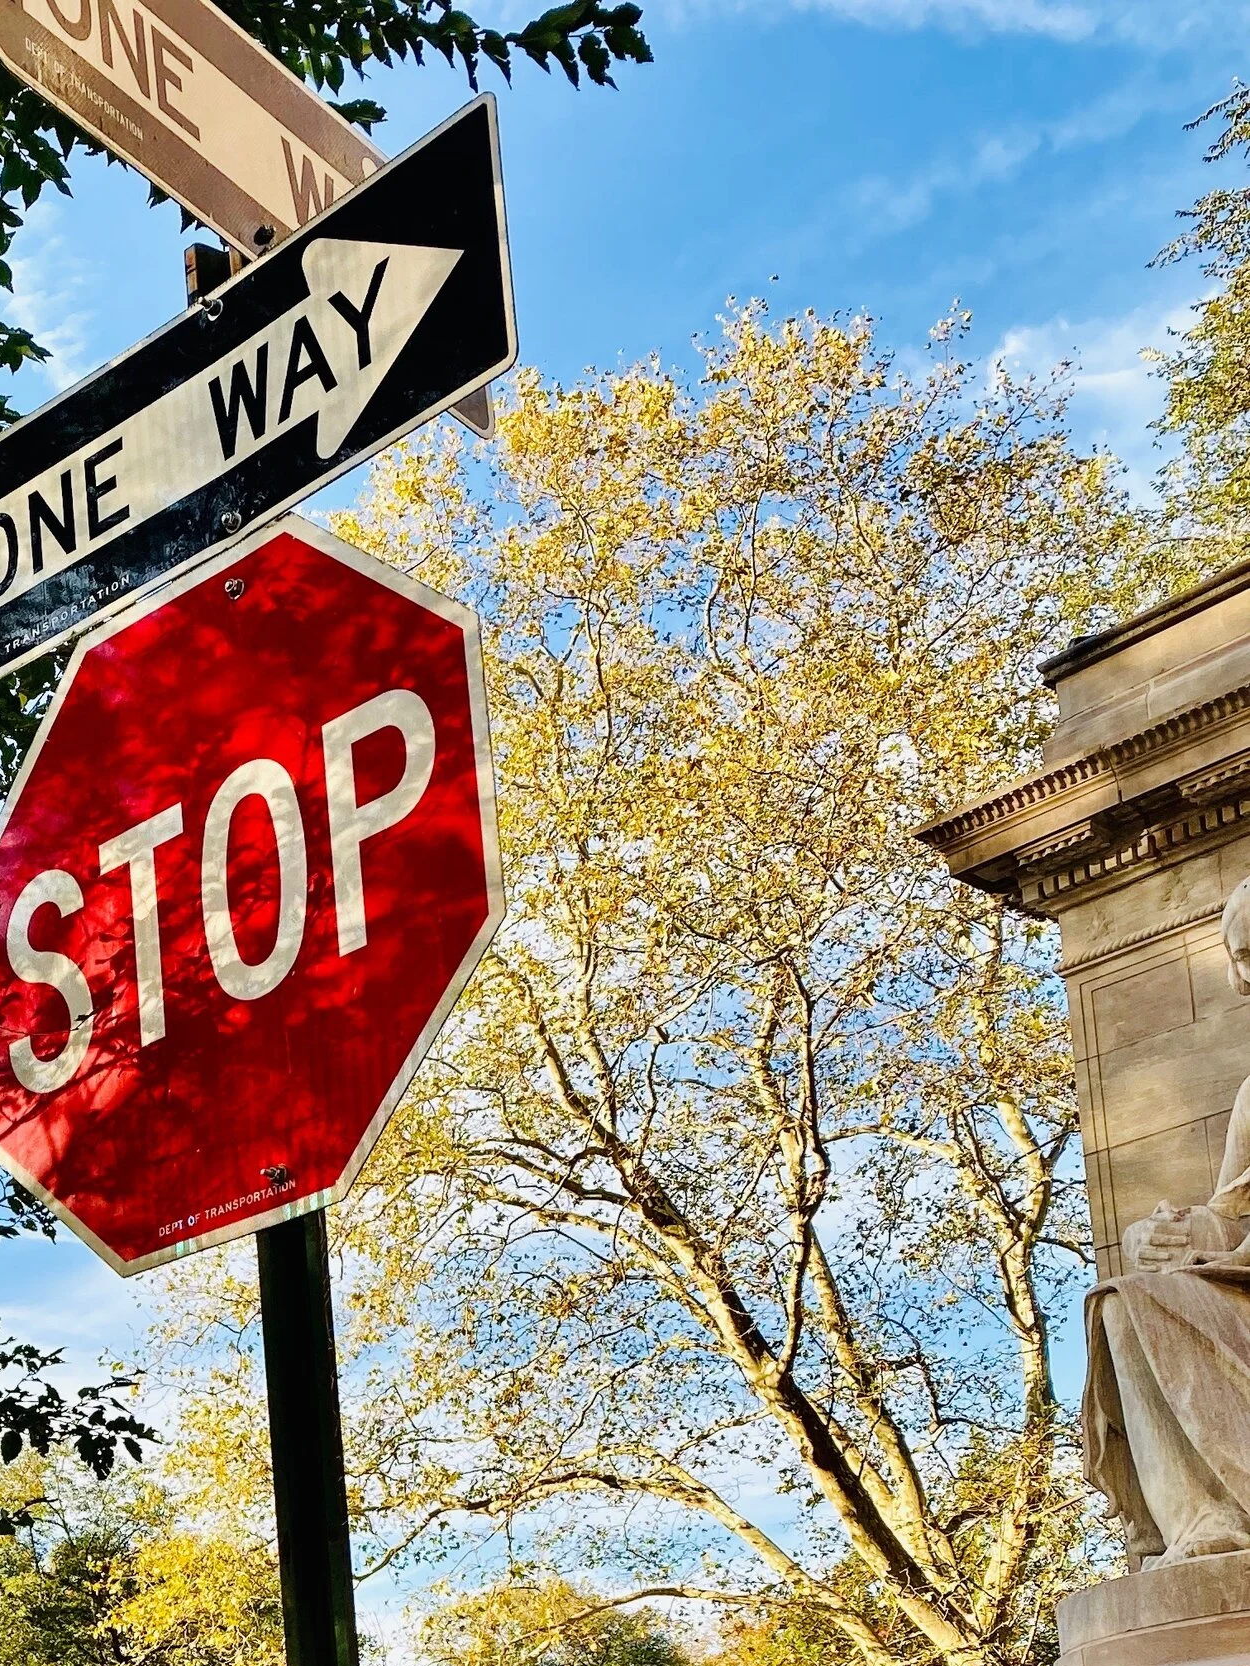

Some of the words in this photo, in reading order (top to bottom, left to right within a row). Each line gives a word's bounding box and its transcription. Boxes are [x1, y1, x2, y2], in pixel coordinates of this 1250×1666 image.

[70, 70, 144, 141] TRANSPORTATION
[208, 256, 389, 460] WAY
[4, 574, 131, 653] TRANSPORTATION
[6, 689, 436, 1094] STOP
[158, 1219, 184, 1237] DEPT
[187, 1213, 201, 1227] OF
[204, 1178, 297, 1220] TRANSPORTATION
